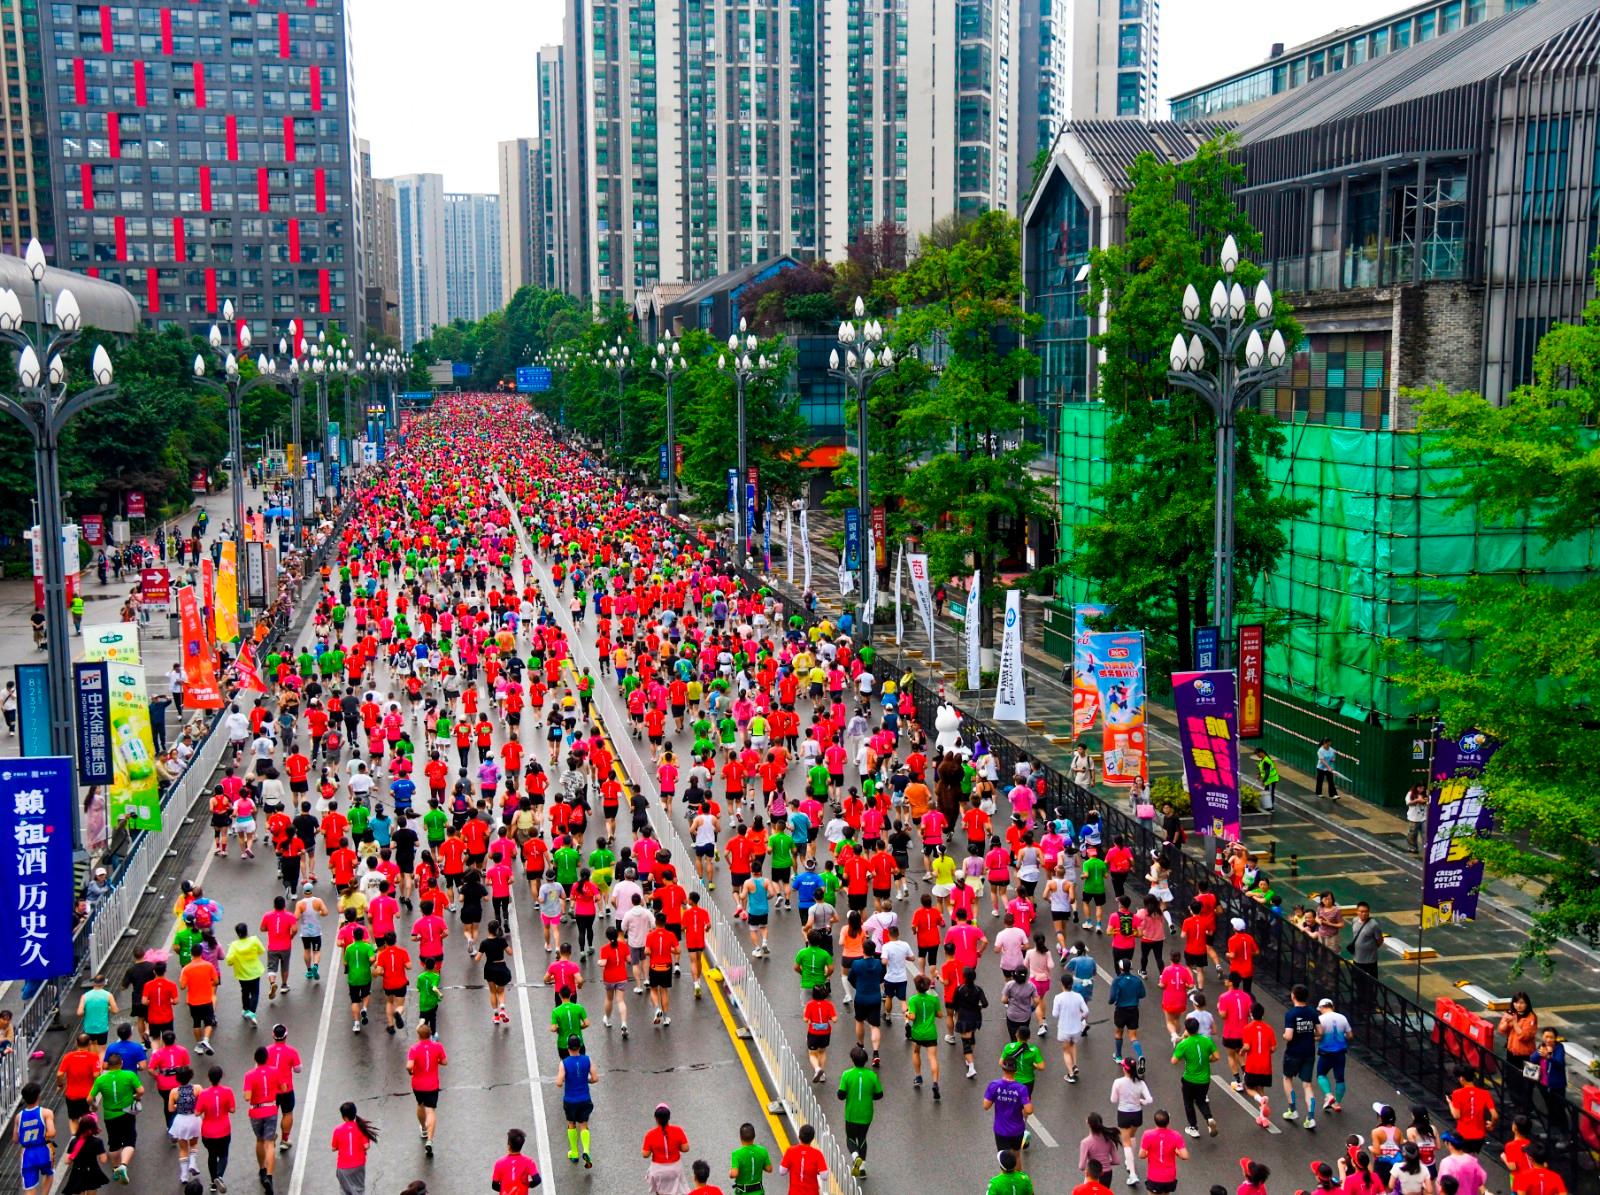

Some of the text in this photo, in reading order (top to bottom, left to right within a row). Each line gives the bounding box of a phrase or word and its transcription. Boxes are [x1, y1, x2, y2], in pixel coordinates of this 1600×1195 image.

[81, 673, 100, 686] ZTF
[88, 693, 106, 775] 中天金融集团
